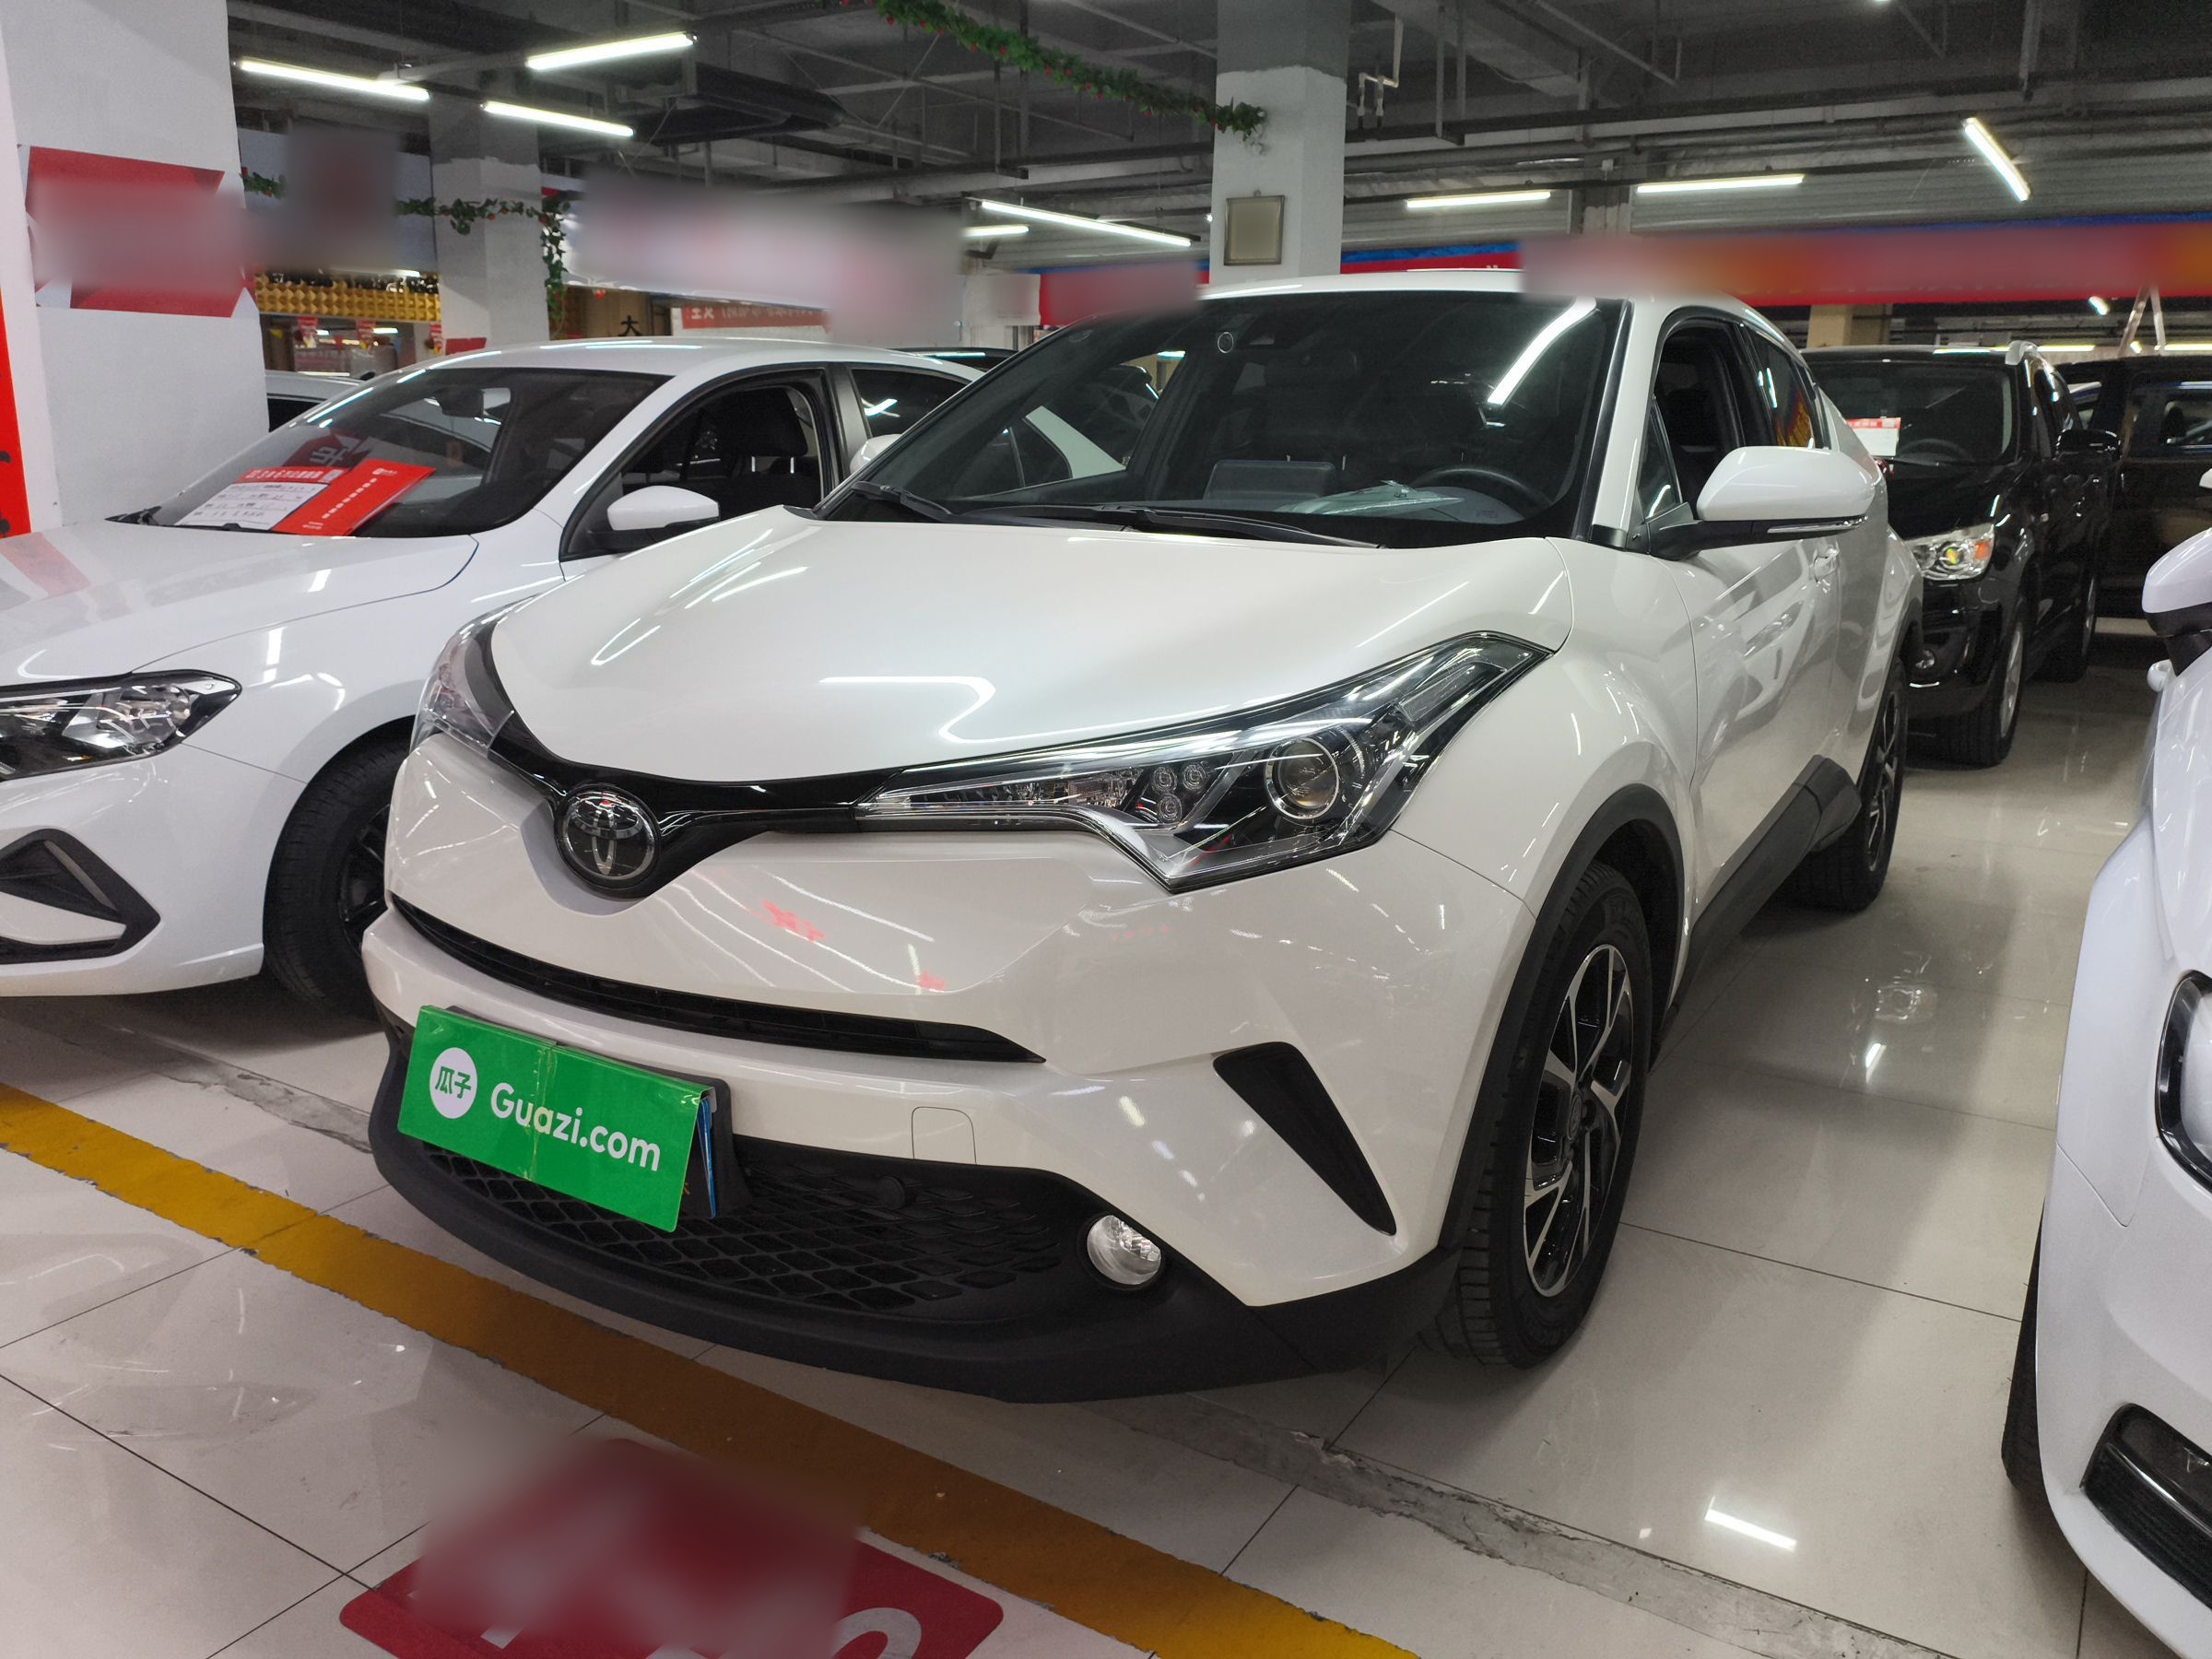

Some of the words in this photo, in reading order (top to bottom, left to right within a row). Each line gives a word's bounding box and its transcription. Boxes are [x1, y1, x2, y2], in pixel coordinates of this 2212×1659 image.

[618, 314, 643, 336] 大
[435, 1065, 472, 1099] 瓜子
[490, 1082, 661, 1171] Guazi.com
